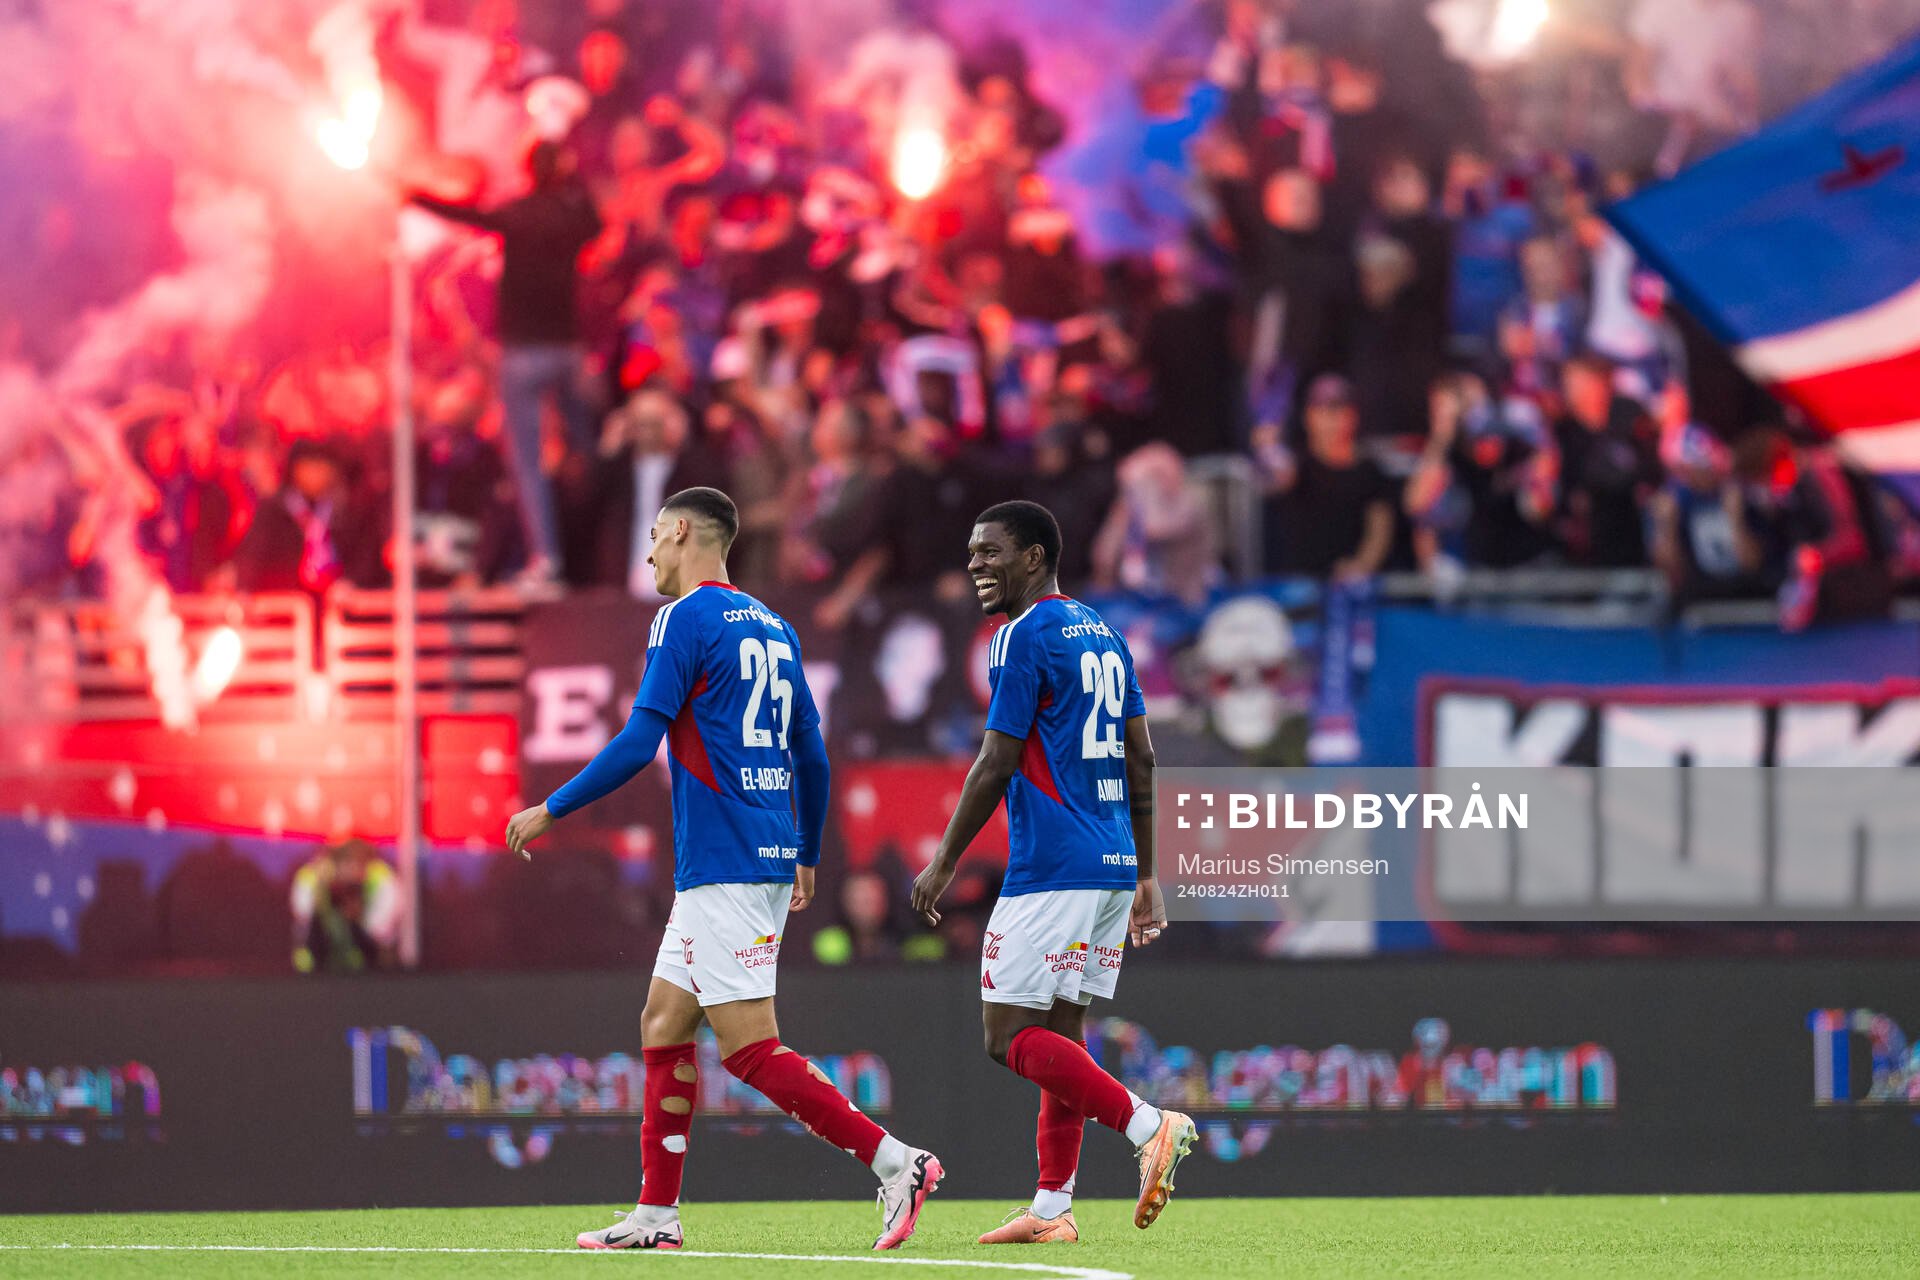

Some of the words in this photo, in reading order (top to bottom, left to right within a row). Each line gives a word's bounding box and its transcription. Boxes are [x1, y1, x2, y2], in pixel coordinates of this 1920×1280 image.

[739, 637, 794, 750] 25
[1081, 651, 1126, 760] 29
[758, 844, 780, 858] mot
[1102, 852, 1121, 865] mot
[735, 944, 779, 960] HURTIG
[1045, 951, 1088, 963] HURTIG
